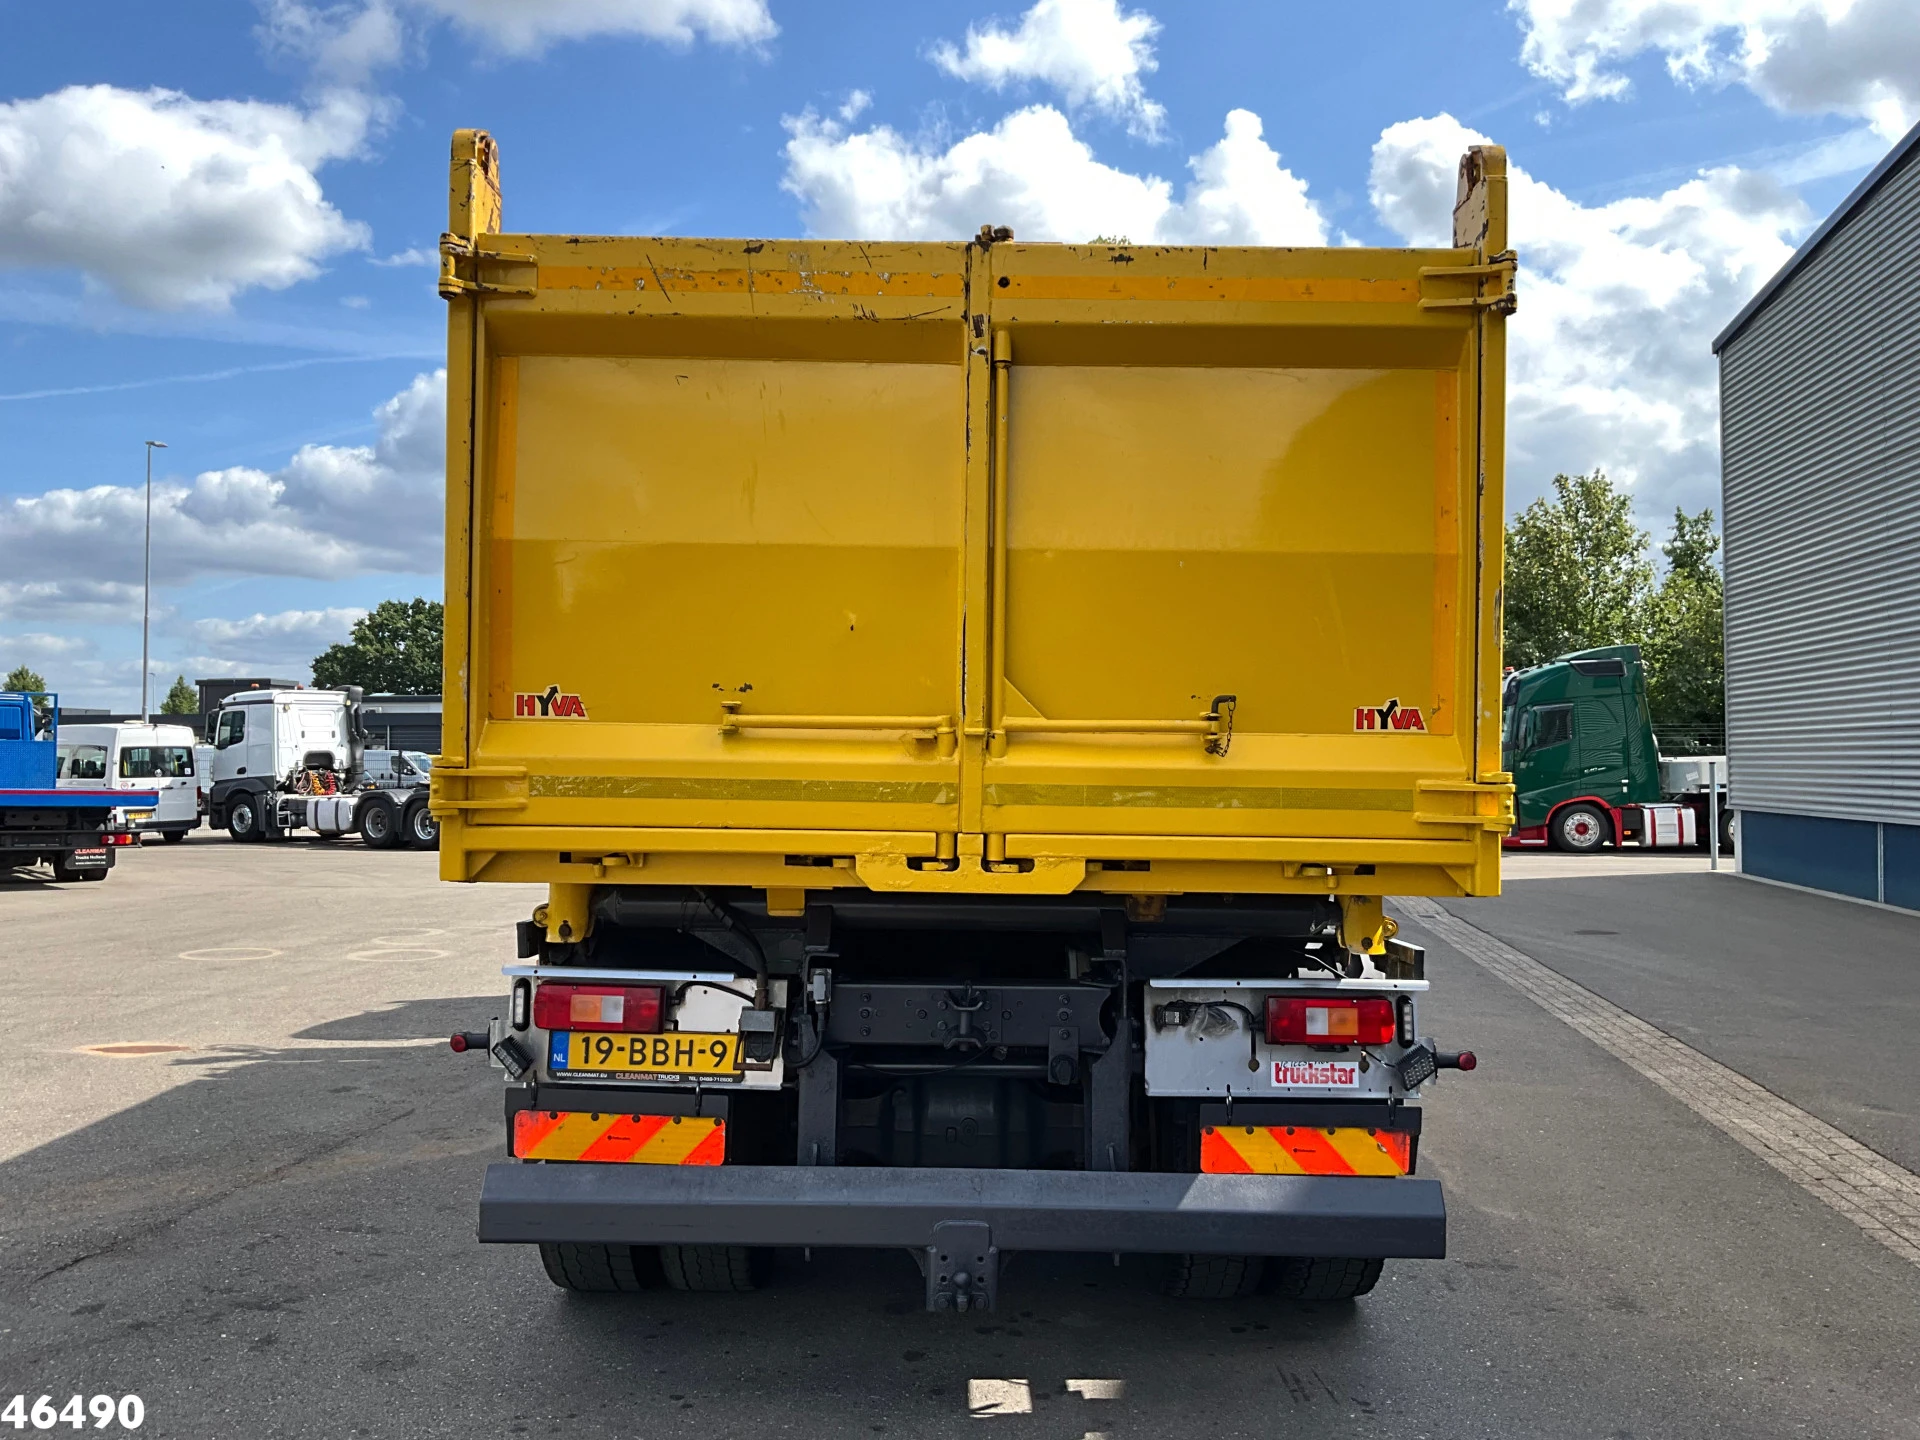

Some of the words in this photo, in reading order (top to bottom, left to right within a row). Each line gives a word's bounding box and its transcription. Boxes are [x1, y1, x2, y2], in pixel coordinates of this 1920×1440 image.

[516, 686, 586, 718] HYVA
[1356, 699, 1425, 731] HYVA
[553, 1053, 566, 1063] NL
[581, 1036, 728, 1068] 19-BBH-9
[1274, 1062, 1356, 1085] truckstar
